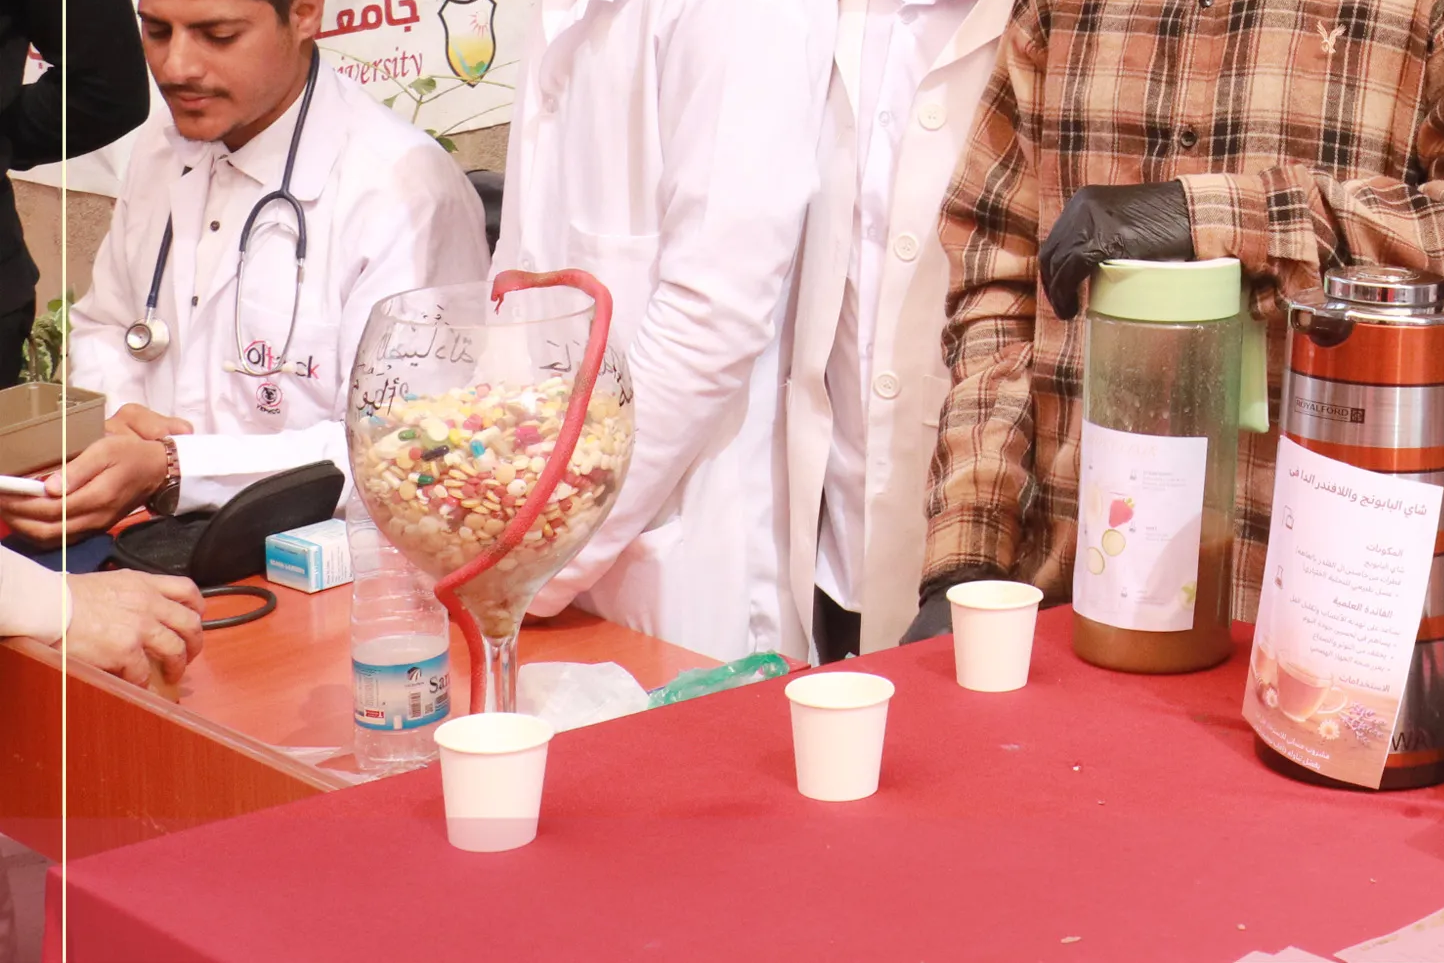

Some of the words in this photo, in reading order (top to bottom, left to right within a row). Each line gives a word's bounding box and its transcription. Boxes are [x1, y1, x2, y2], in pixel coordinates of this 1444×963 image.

[1296, 399, 1349, 417] ROYALFORD
[1359, 493, 1403, 513] البابونج
[1403, 501, 1427, 518] شاي
